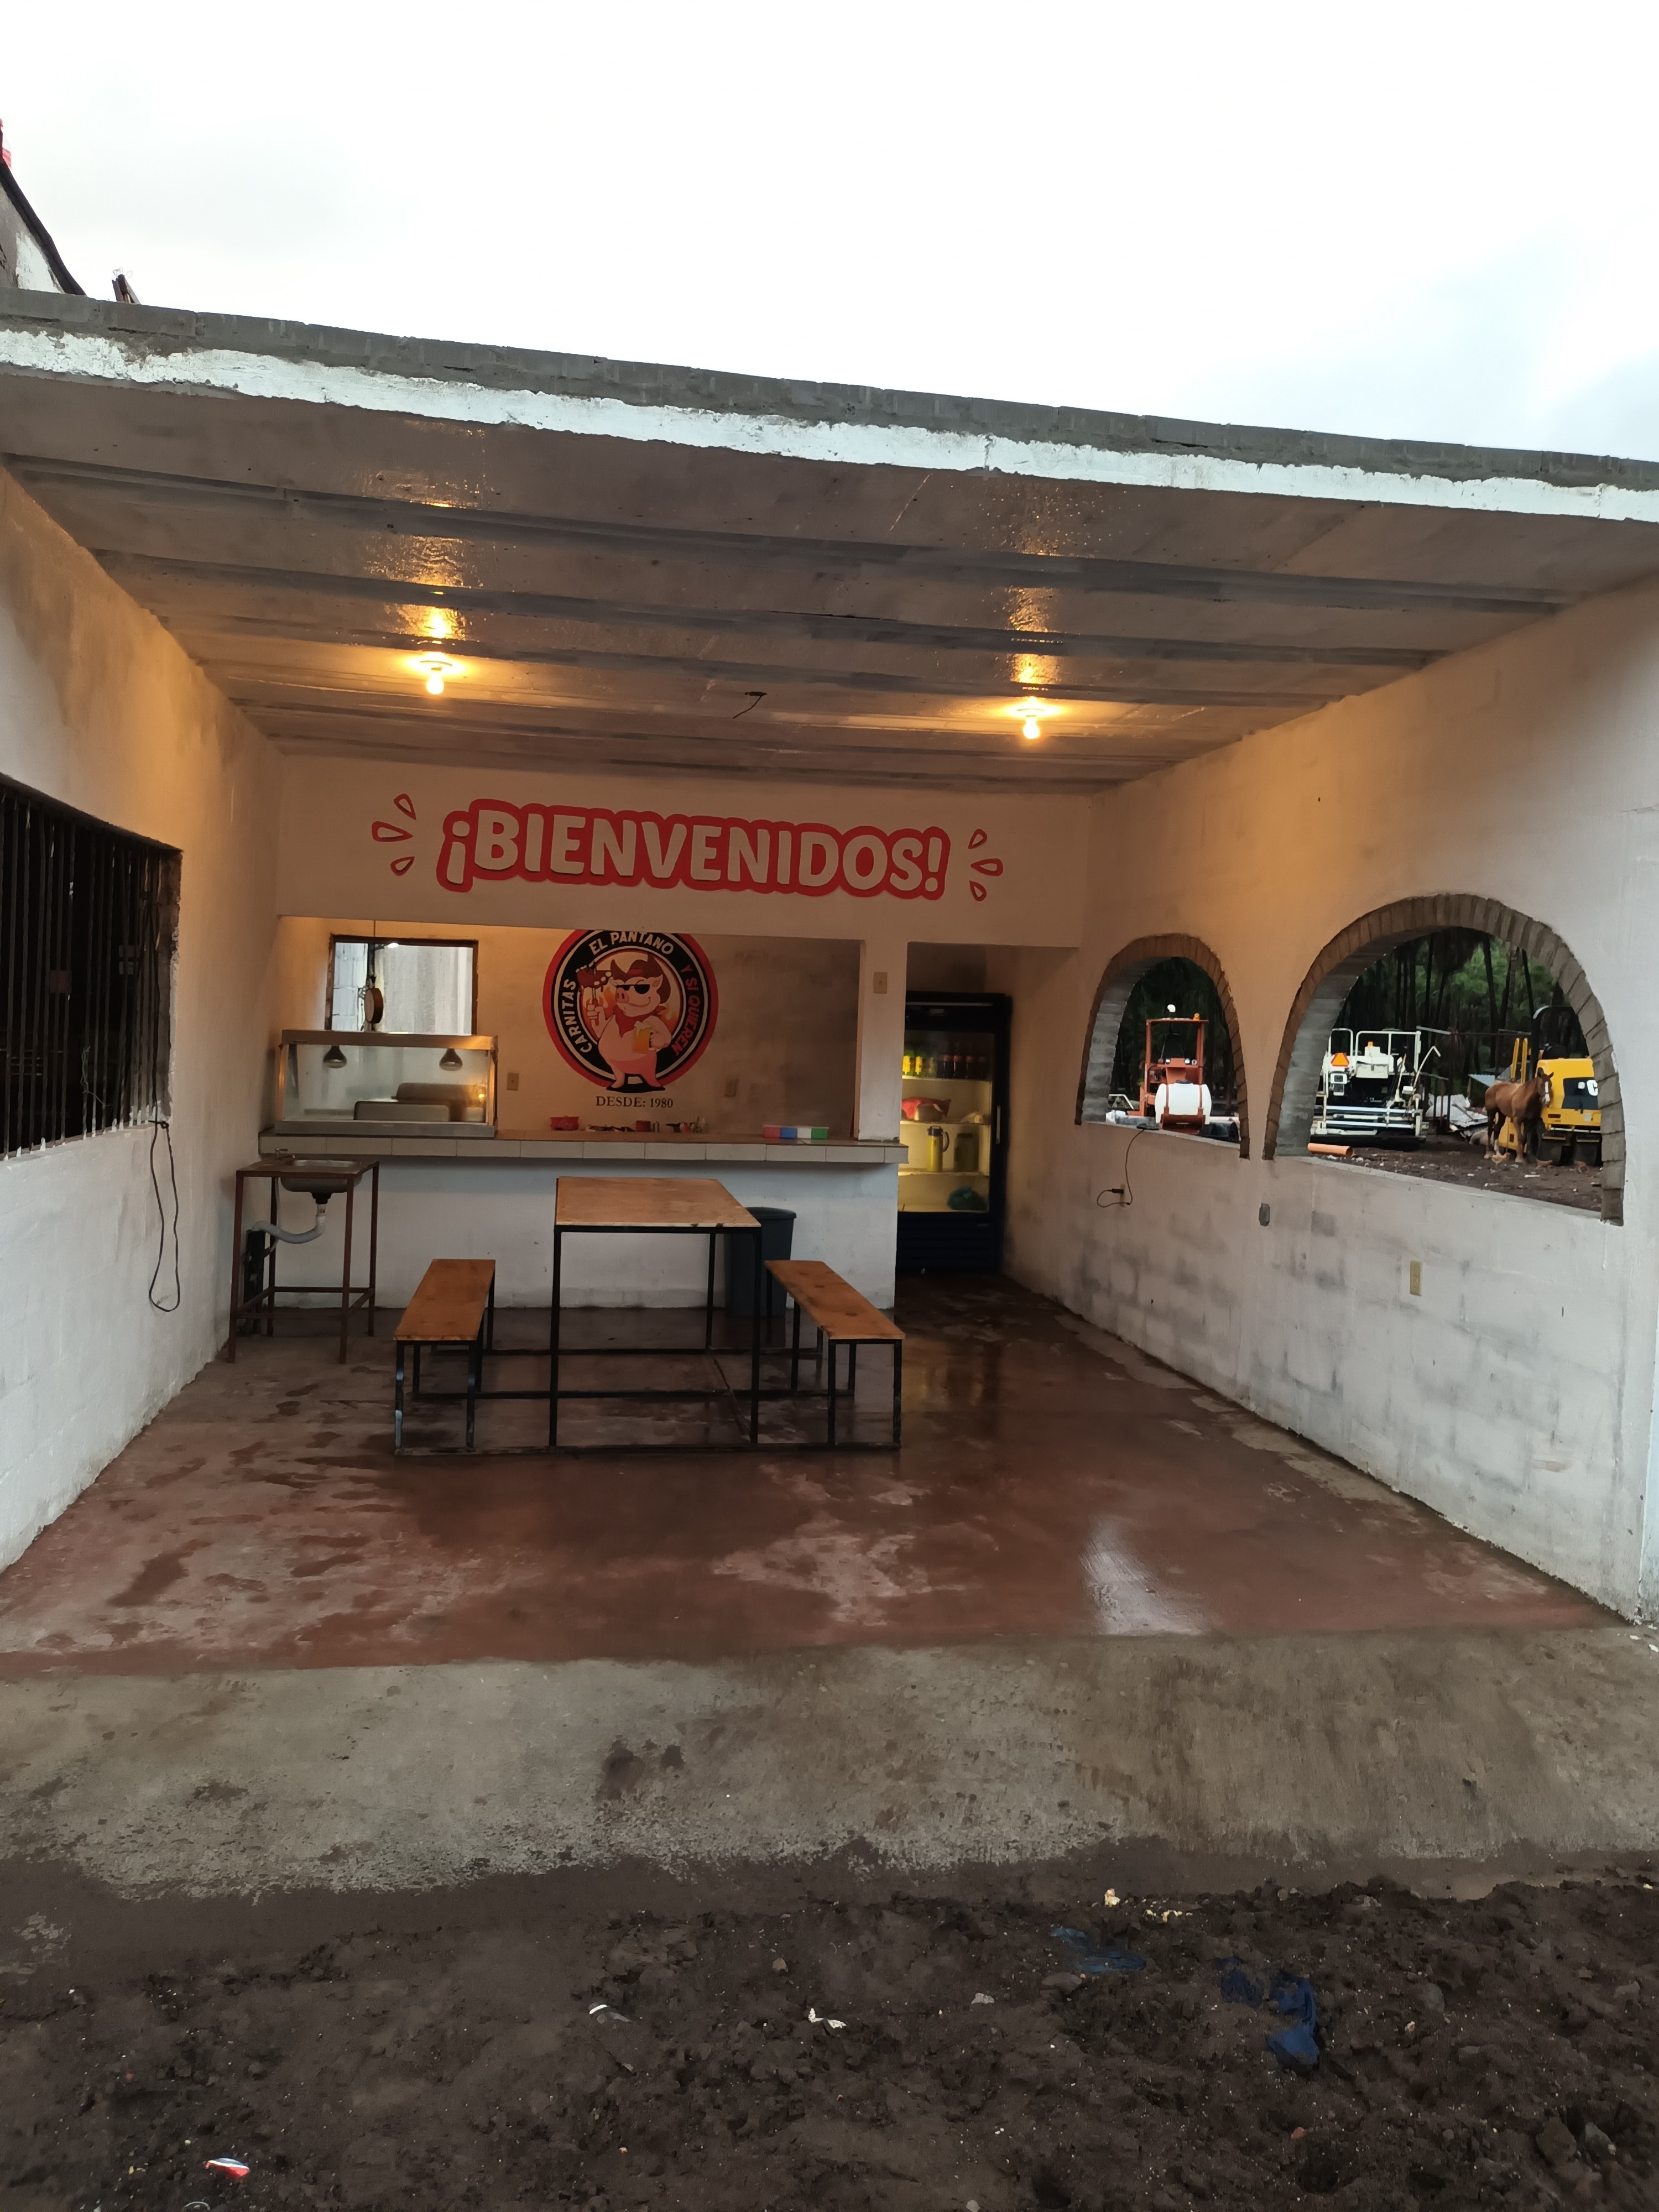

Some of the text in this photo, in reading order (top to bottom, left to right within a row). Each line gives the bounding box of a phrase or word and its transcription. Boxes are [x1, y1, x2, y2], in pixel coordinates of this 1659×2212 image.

[445, 807, 943, 893] ¡BIENVENIDOS!
[562, 931, 701, 1056] CARNITAS EL PANTANO Y SI QUIEREN
[596, 1096, 674, 1108] DESDE: 1980
